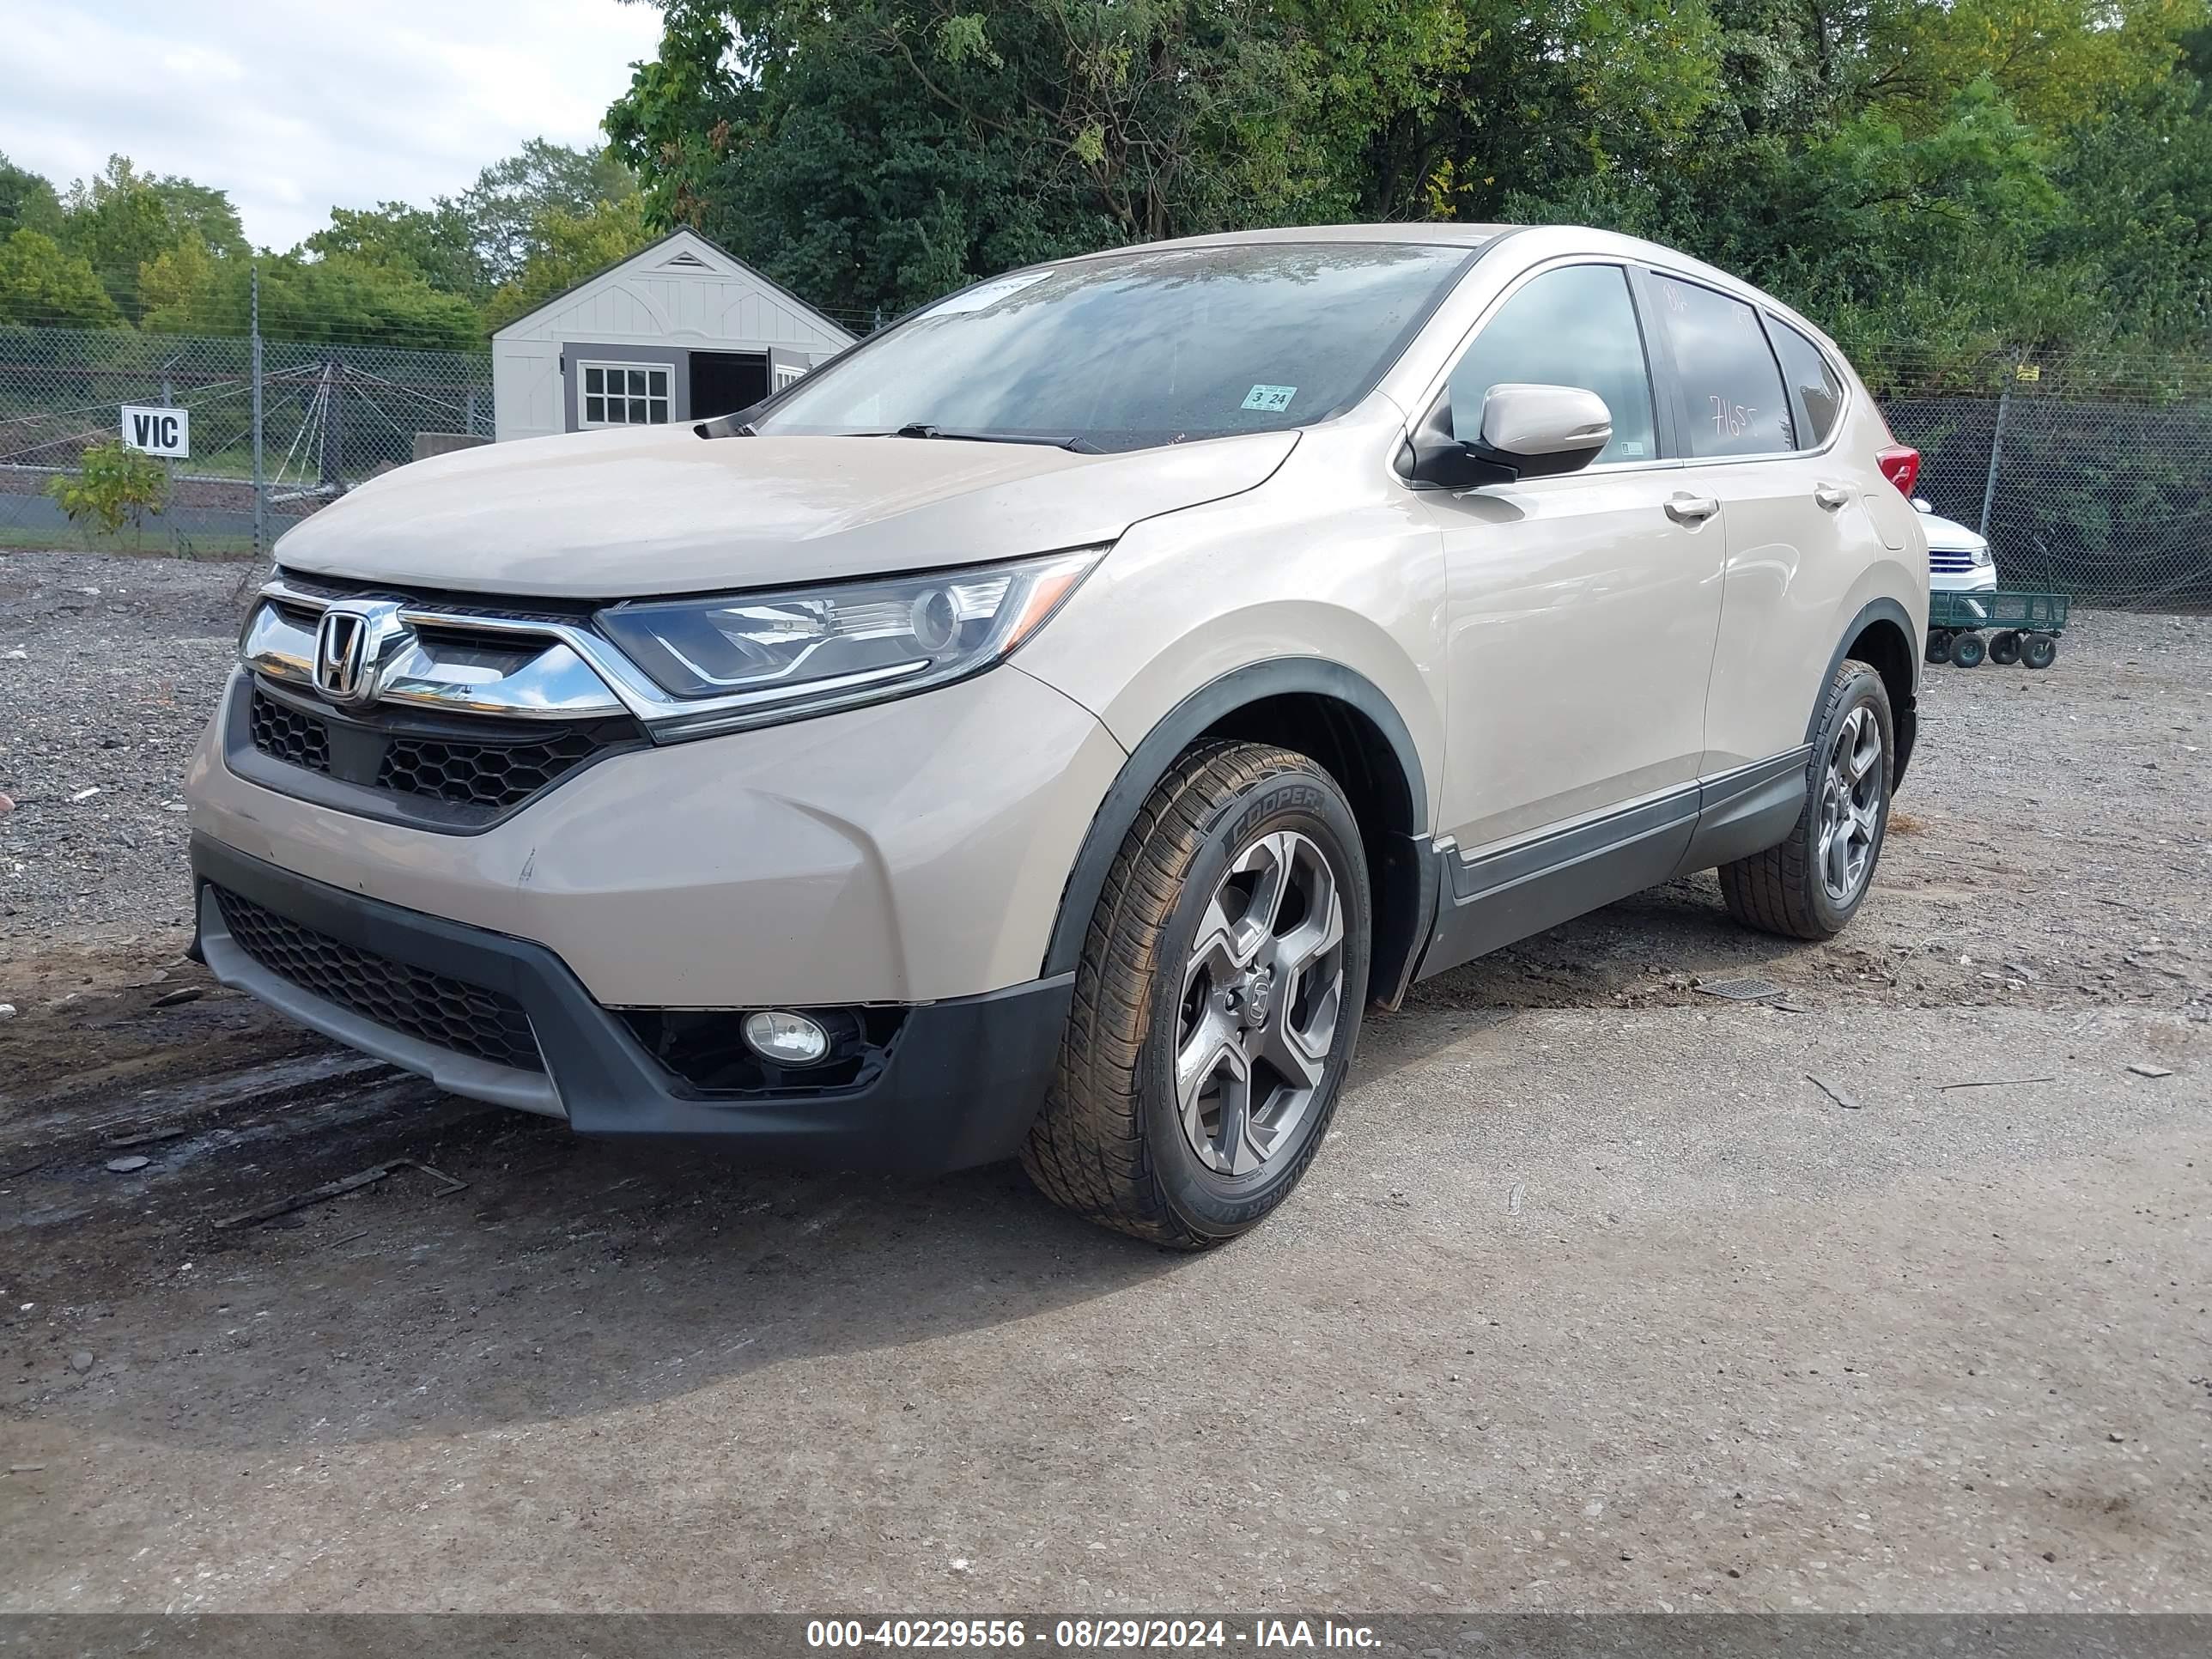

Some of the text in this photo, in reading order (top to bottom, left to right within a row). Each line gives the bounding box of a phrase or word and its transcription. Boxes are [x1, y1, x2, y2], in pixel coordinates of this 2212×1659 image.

[1253, 392, 1286, 404] 3 24
[133, 414, 179, 449] VIC
[1232, 787, 1318, 845] COOPER
